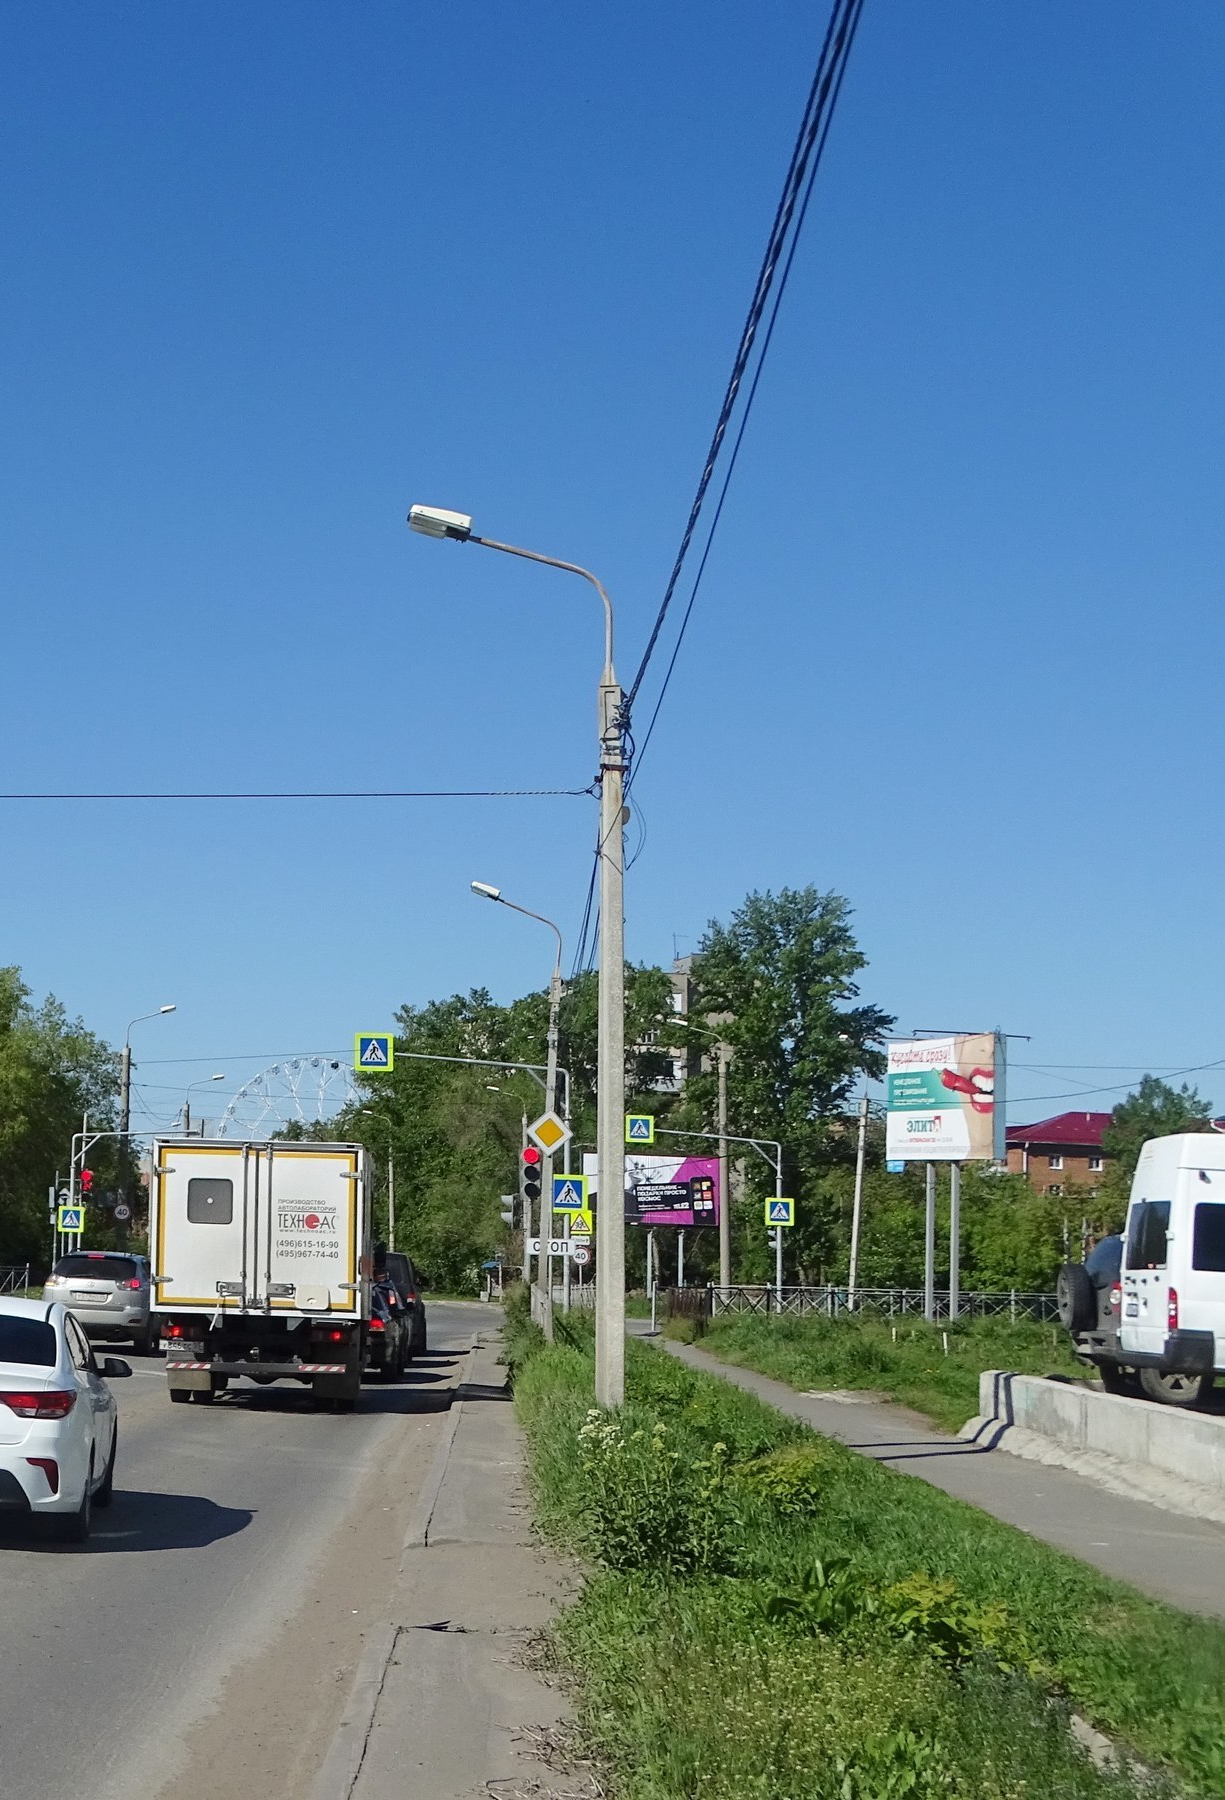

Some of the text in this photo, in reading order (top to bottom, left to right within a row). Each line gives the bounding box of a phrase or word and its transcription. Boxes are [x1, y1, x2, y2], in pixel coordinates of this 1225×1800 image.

[276, 1240, 339, 1248] (496)615-16-90
[533, 1241, 569, 1252] СОП
[276, 1250, 339, 1258] (495)967-74-40
[575, 1252, 586, 1260] 40
